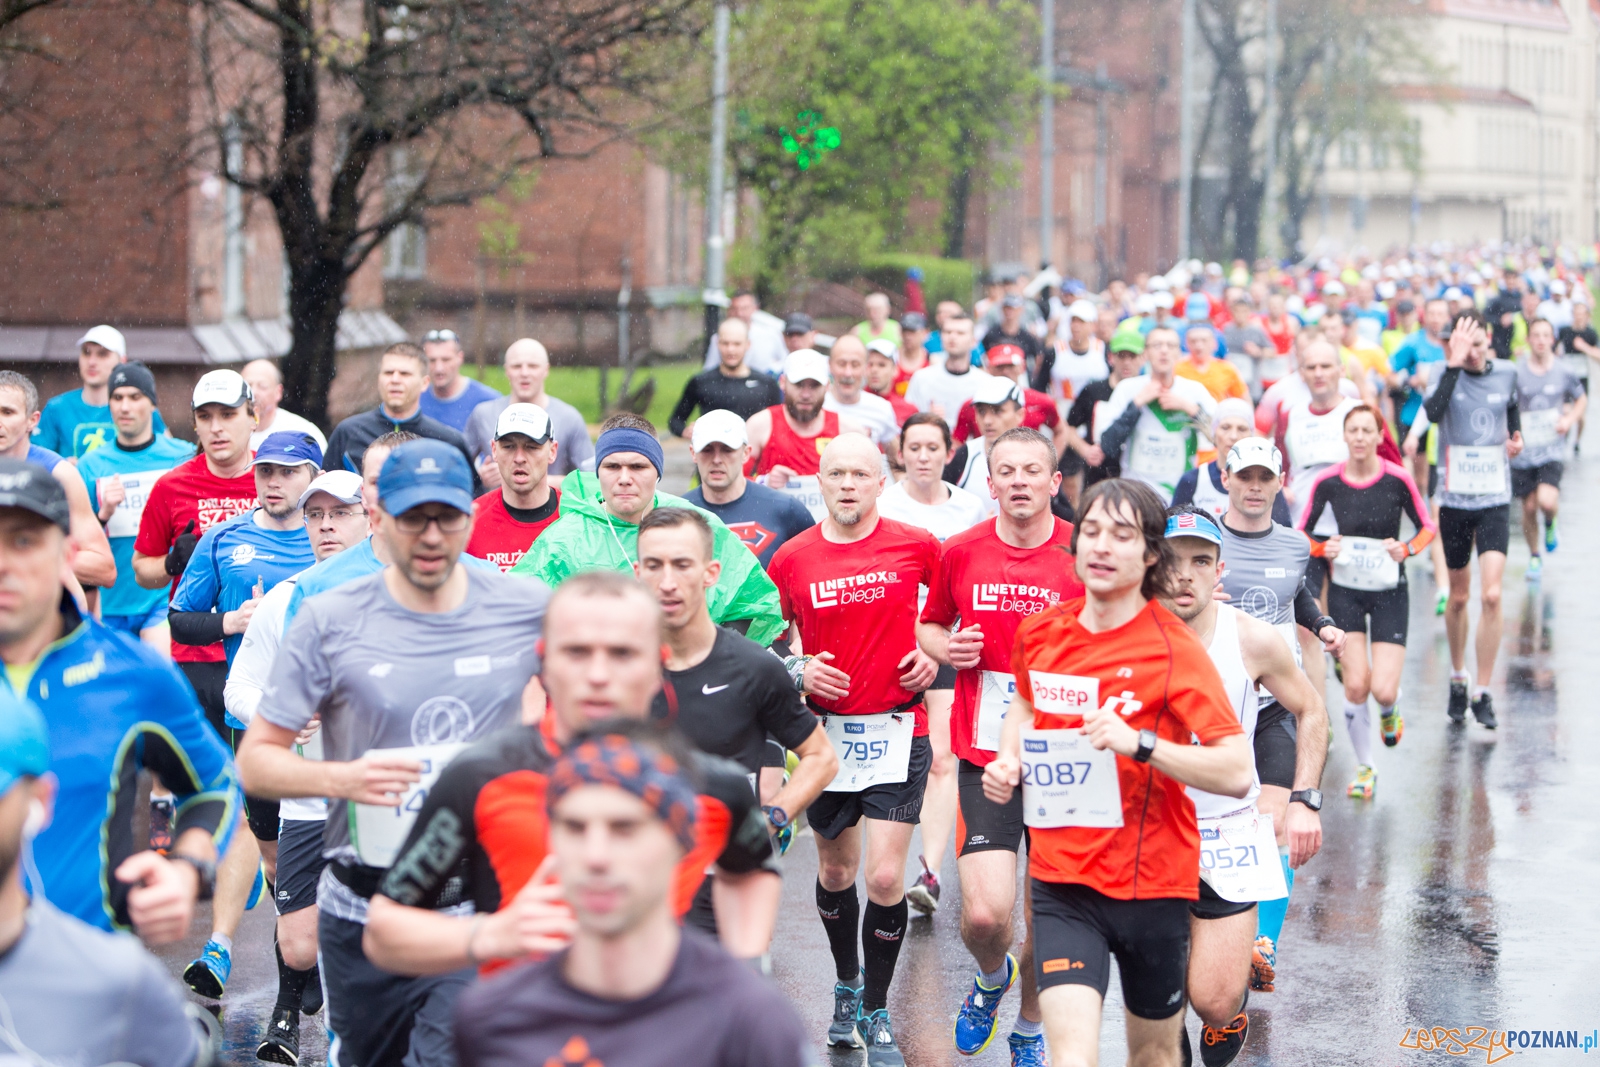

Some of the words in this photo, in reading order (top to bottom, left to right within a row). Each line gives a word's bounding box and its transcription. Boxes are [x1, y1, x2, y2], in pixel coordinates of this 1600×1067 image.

[825, 570, 888, 591] NETBOX
[840, 585, 886, 605] biega
[988, 583, 1051, 600] NETBOX
[1000, 596, 1045, 616] biega
[842, 740, 889, 760] 7951
